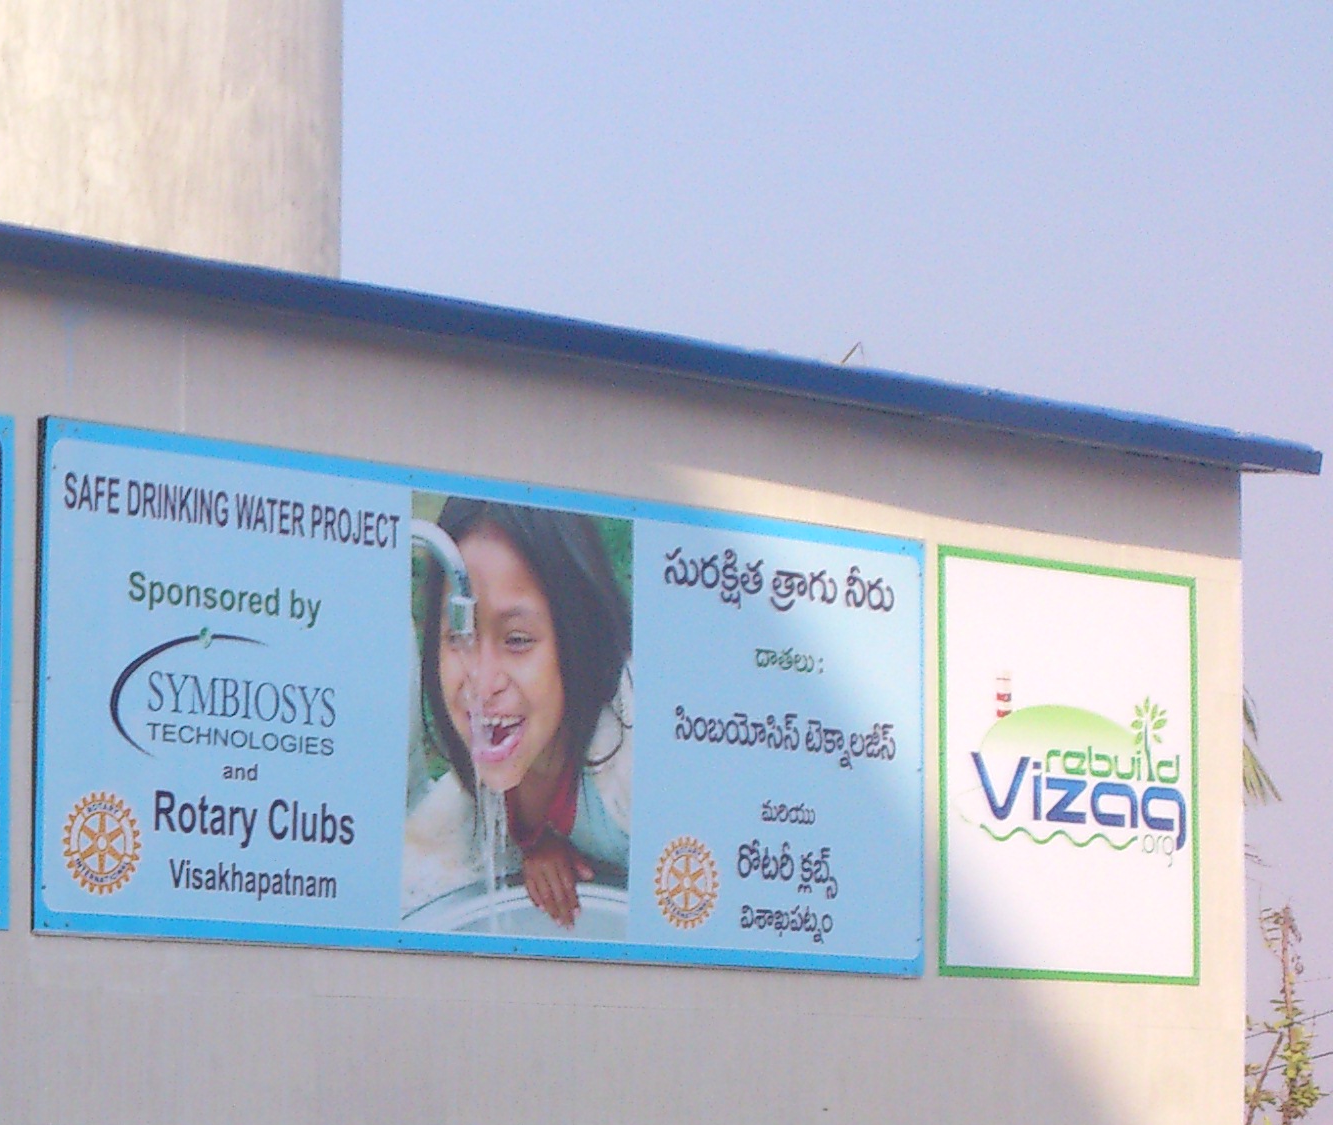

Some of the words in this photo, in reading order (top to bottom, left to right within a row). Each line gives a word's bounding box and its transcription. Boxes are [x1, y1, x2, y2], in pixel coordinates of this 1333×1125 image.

[64, 471, 120, 514] SAFE
[127, 481, 229, 527] DRINKING
[236, 494, 306, 537] WATER
[310, 503, 402, 549] PROJECT
[128, 571, 280, 617] Sponsored
[289, 589, 322, 626] by
[845, 565, 896, 612] నీరు
[147, 670, 337, 729] SYMBIOSYS
[147, 722, 334, 757] TECHNOLOGIES
[1045, 746, 1180, 784] rebuild
[223, 763, 259, 782] and
[154, 790, 258, 849] Rotary
[268, 798, 356, 845] Clubs
[971, 752, 1187, 851] Vizag
[169, 858, 338, 901] Visakhapatnam
